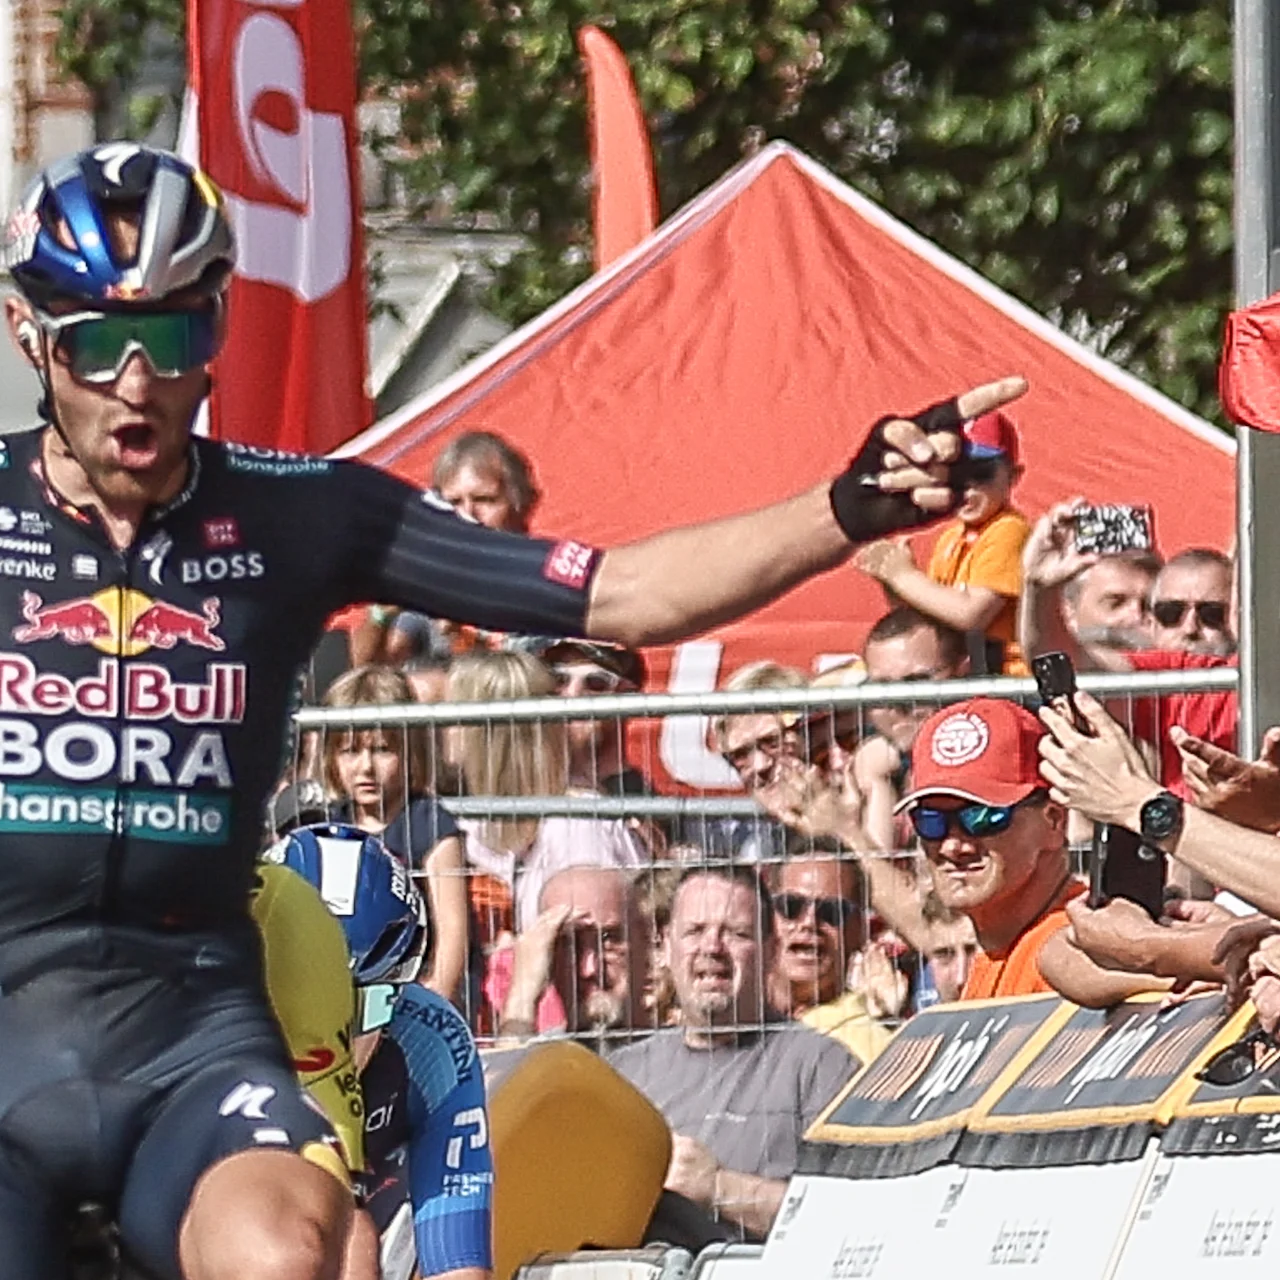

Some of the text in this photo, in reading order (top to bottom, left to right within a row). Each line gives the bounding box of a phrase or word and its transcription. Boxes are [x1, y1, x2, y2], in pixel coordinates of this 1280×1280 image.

[182, 554, 266, 583] BOSS
[124, 661, 247, 725] Bull
[399, 999, 473, 1087] FANTINI
[443, 1184, 480, 1197] TECH
